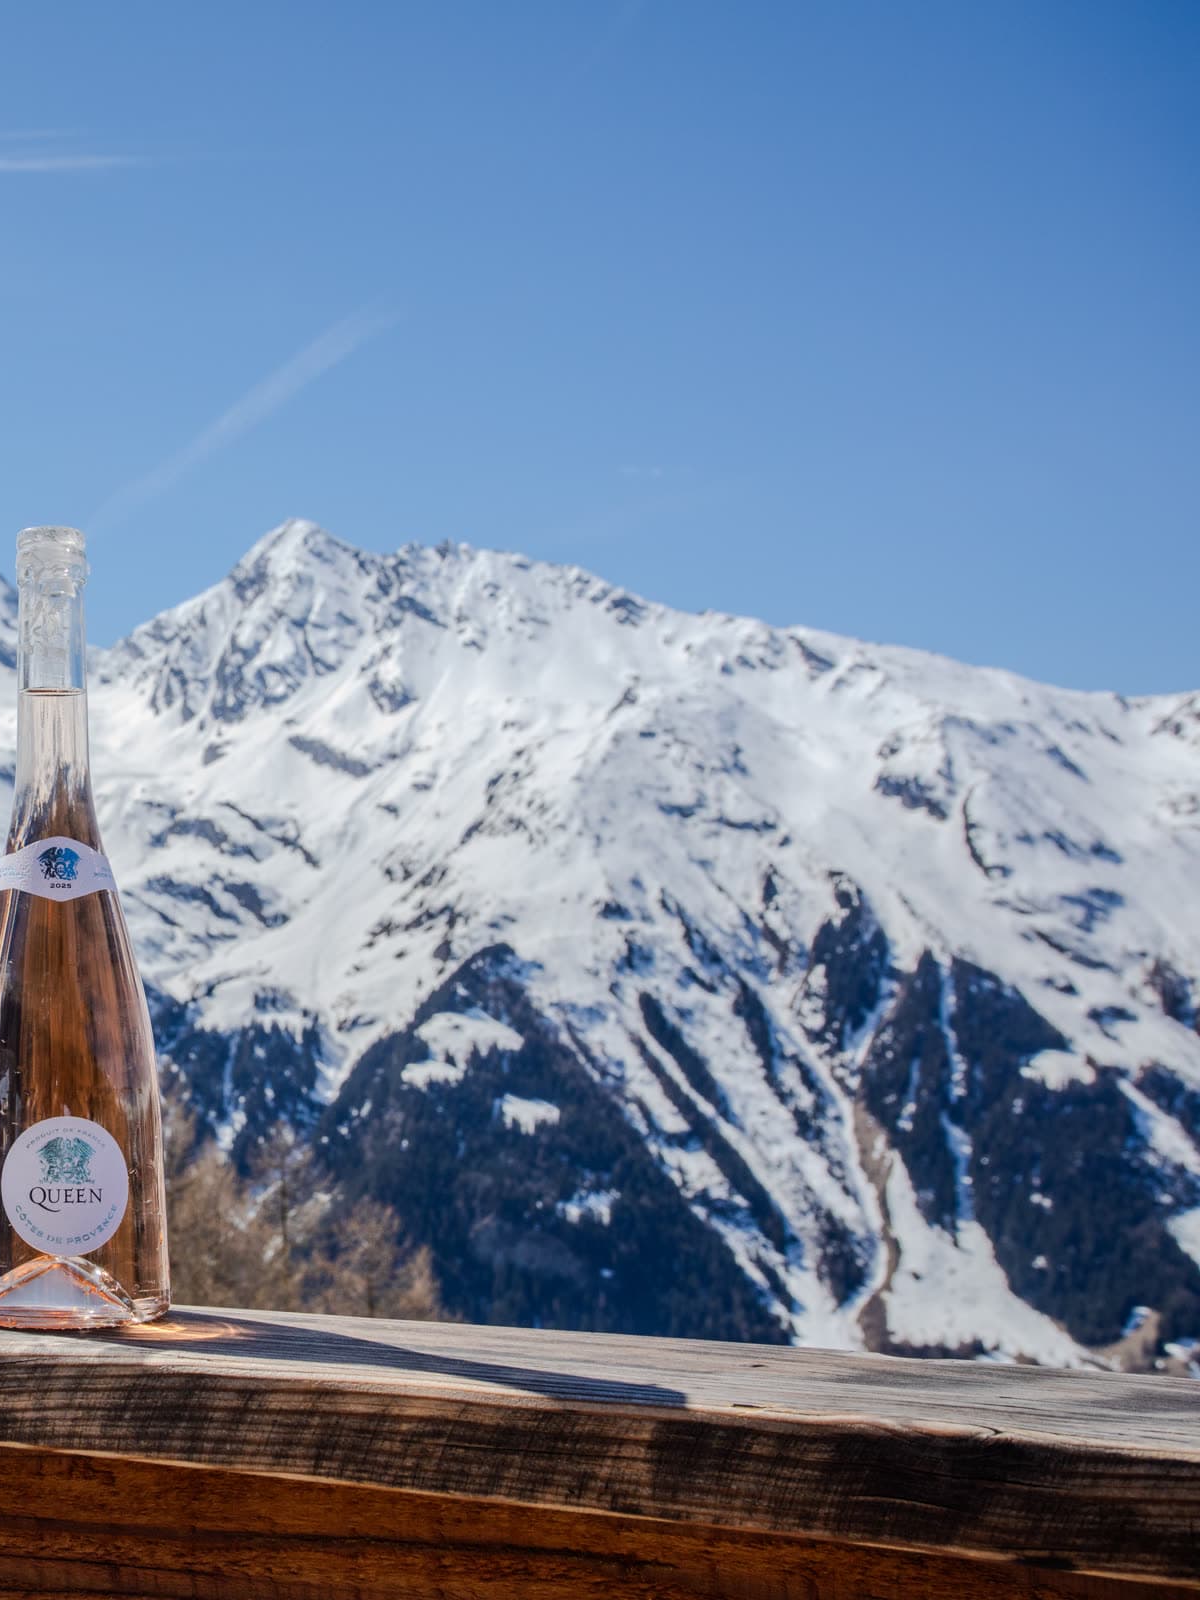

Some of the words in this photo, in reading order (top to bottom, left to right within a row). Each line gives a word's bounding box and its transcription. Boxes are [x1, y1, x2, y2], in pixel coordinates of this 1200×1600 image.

[29, 1186, 102, 1213] QUEEN
[46, 1234, 63, 1245] DE
[66, 1204, 118, 1244] PROVENCE
